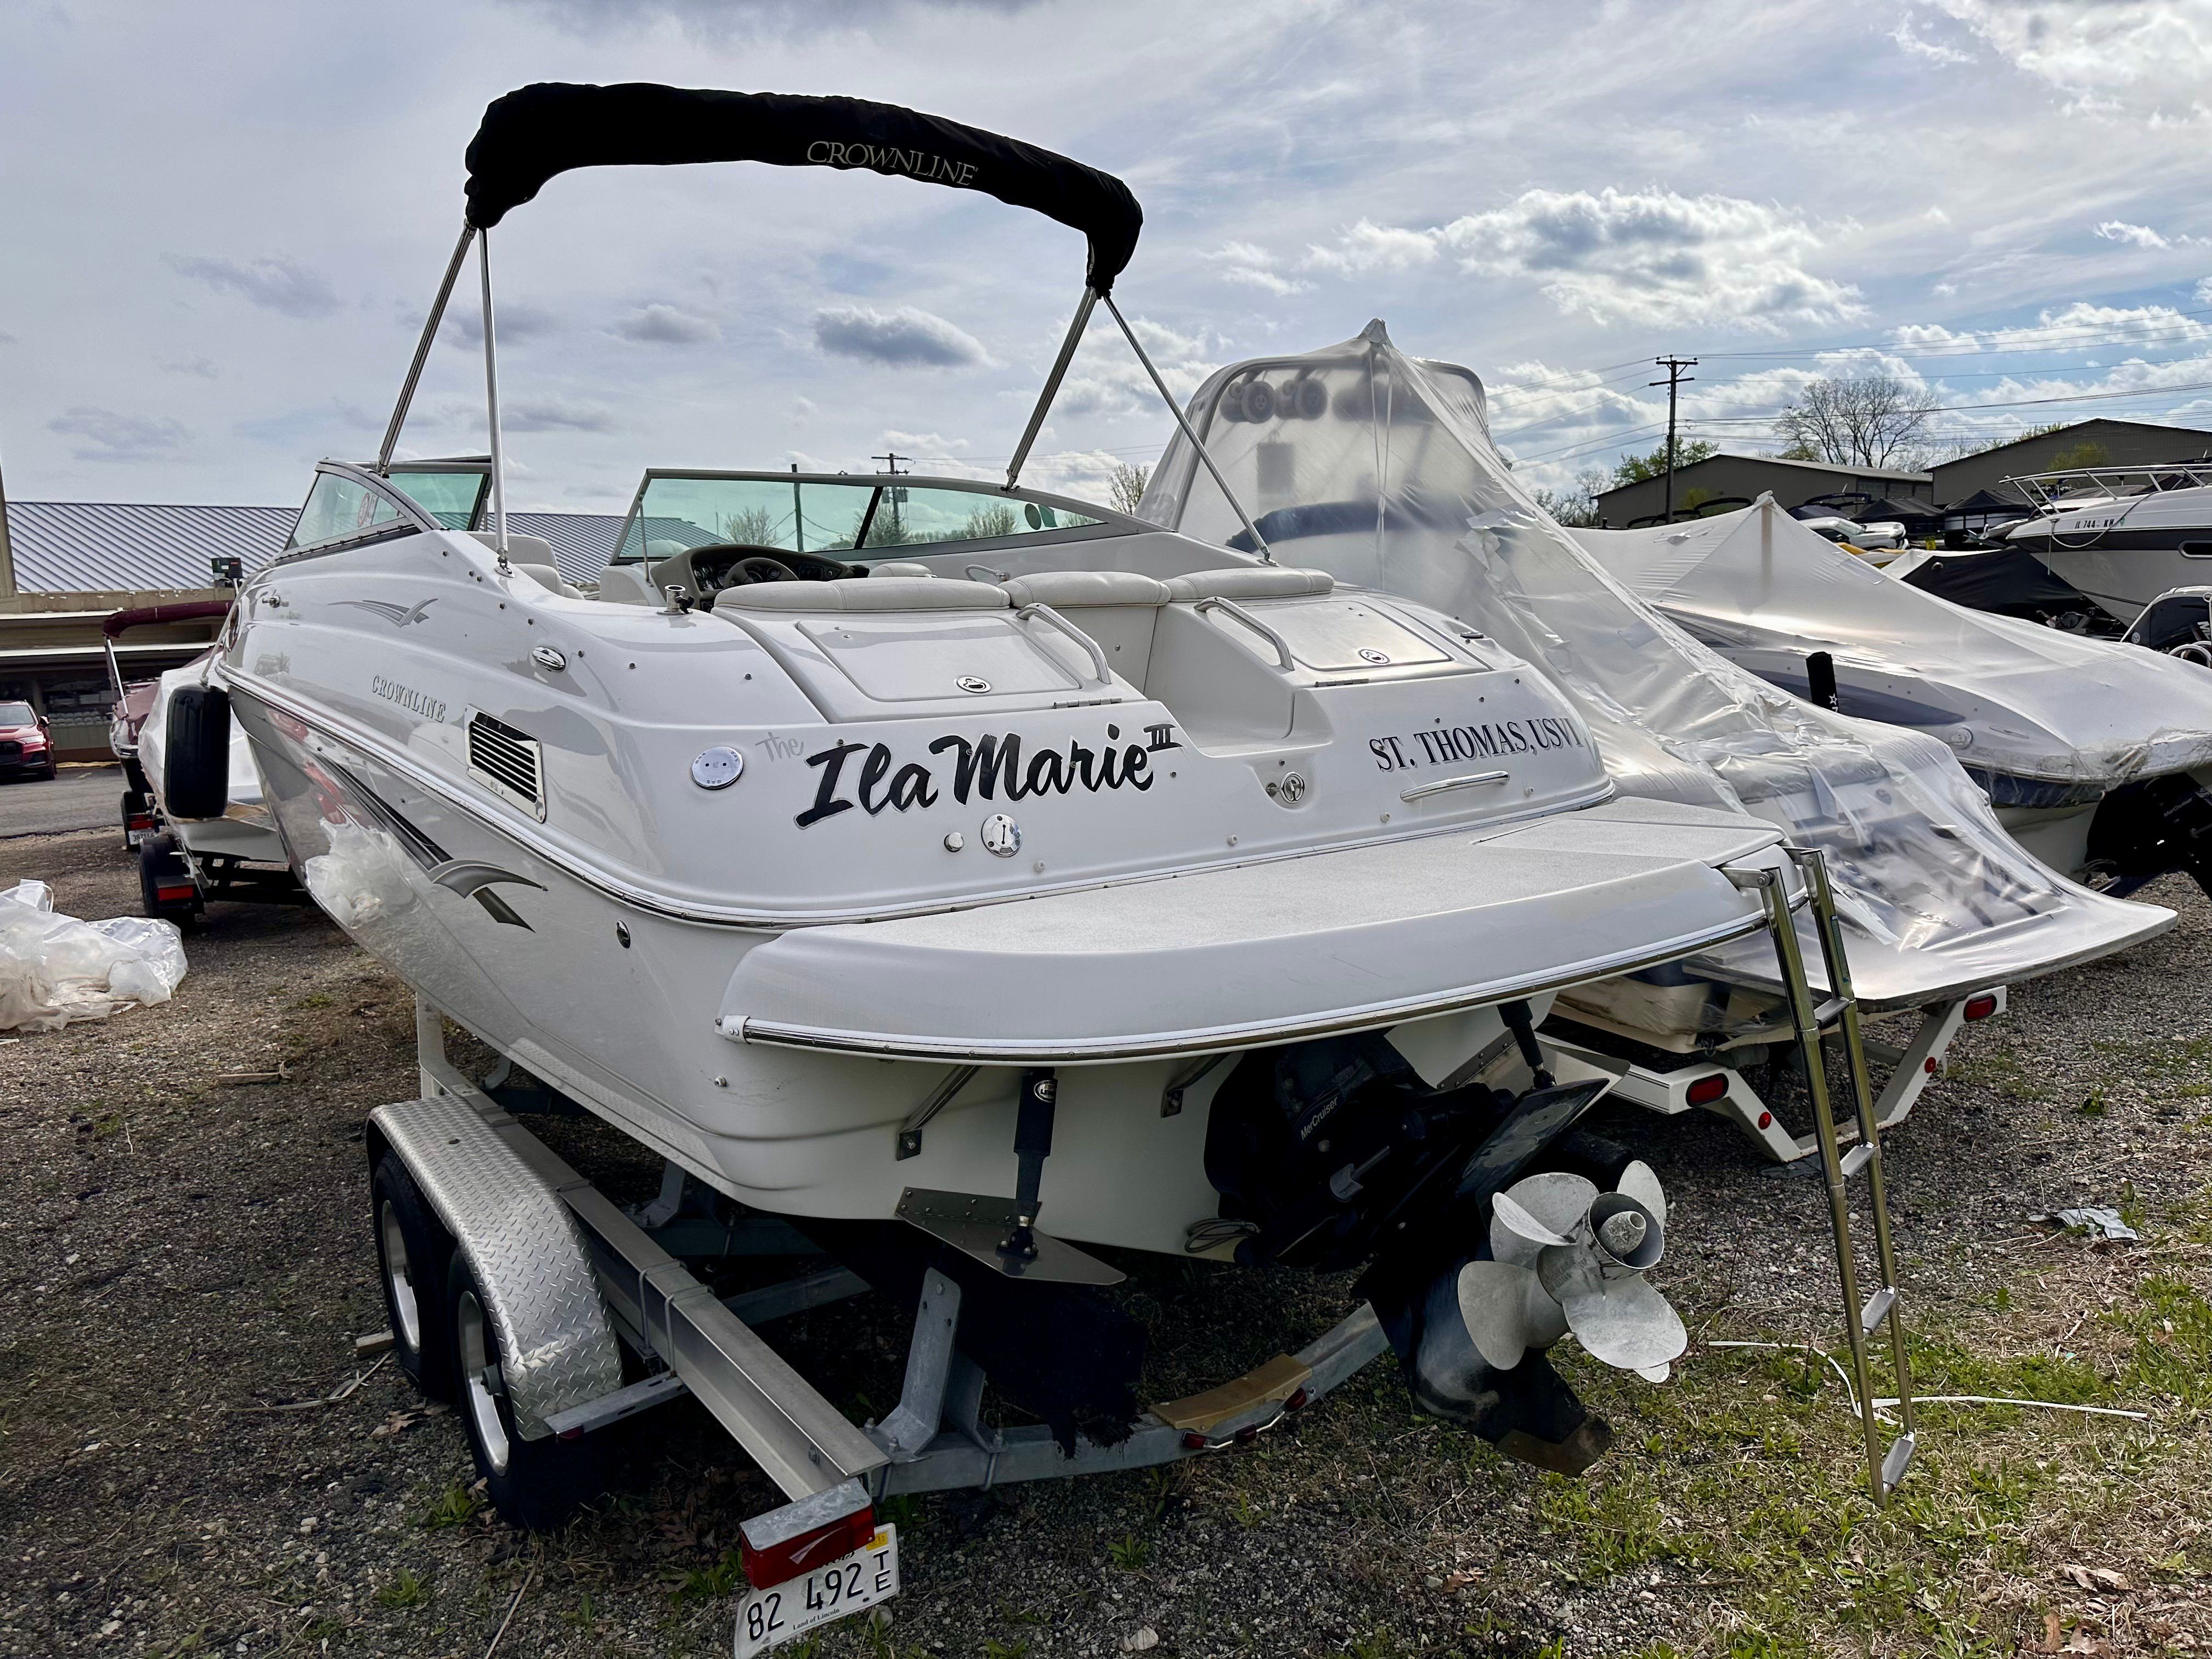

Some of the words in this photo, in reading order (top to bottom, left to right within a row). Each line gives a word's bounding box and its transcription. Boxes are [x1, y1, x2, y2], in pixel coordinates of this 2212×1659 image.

[807, 140, 977, 185] CROWNLINE
[372, 675, 446, 723] CROWNLINE
[1369, 736, 1418, 772] ST.
[755, 731, 805, 762] The
[794, 742, 939, 830] Ila
[929, 724, 1154, 805] Marie
[1144, 724, 1184, 753] III
[1300, 1096, 1339, 1141] MerCruiser
[747, 1593, 784, 1640] 82
[806, 1563, 864, 1610] 492
[793, 1619, 809, 1630] Land
[817, 1608, 840, 1620] Lincoln
